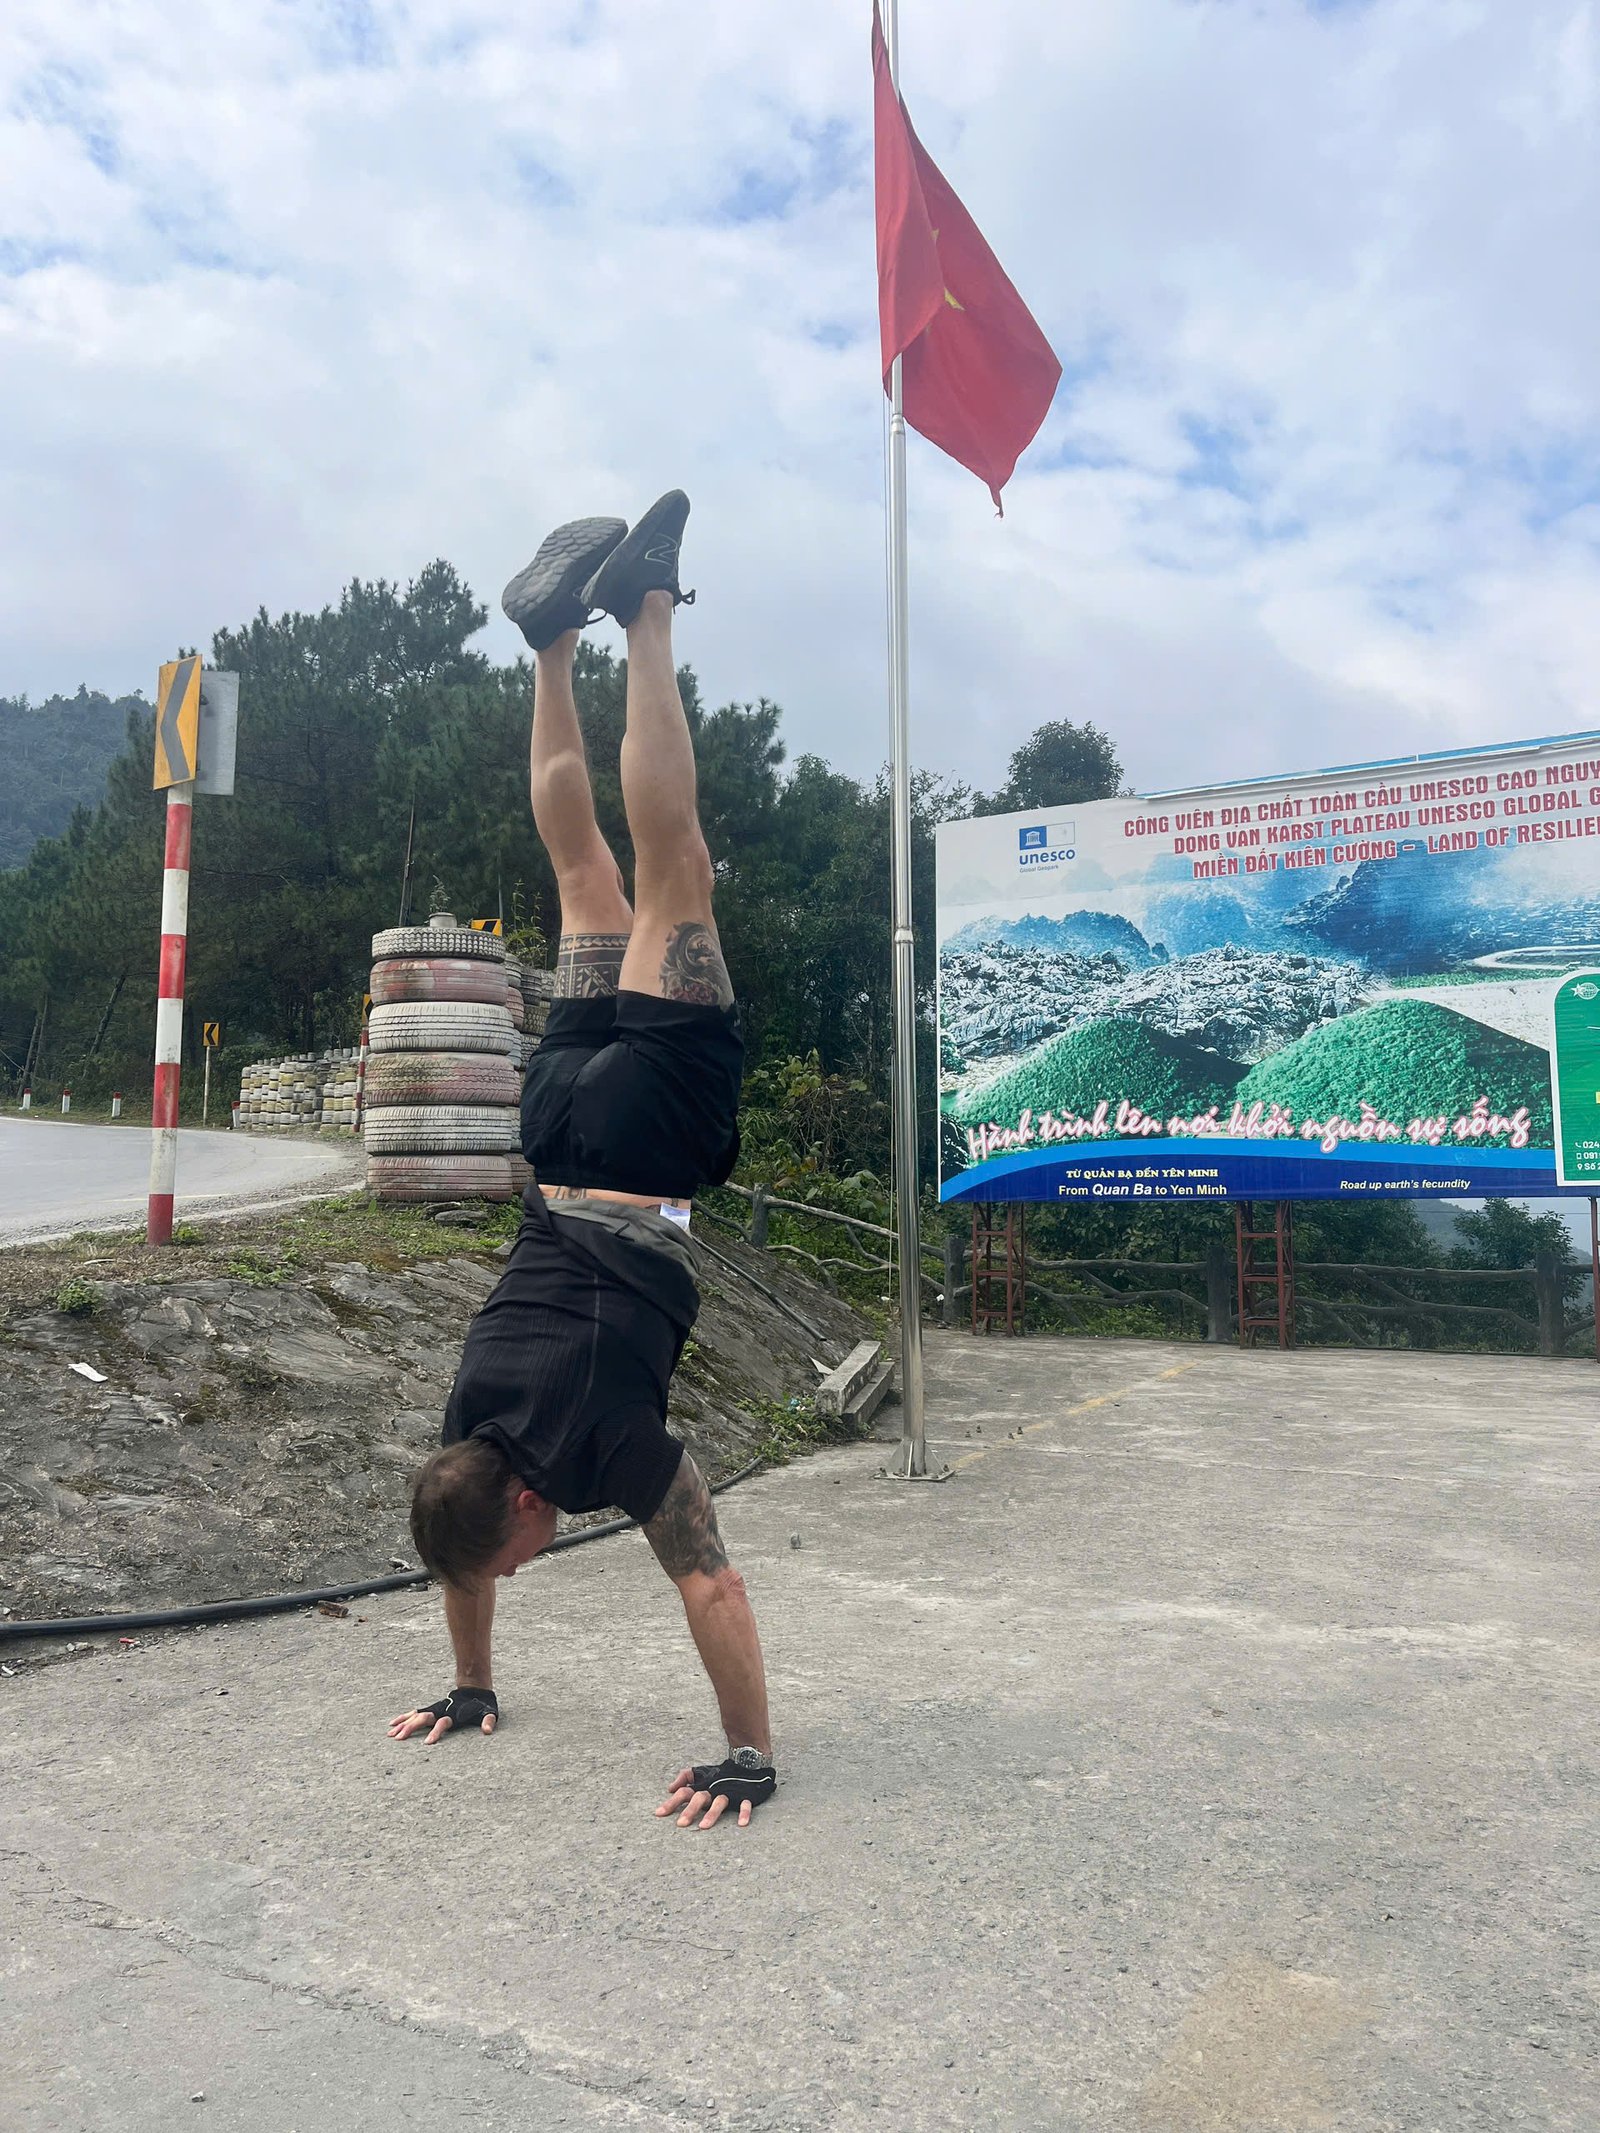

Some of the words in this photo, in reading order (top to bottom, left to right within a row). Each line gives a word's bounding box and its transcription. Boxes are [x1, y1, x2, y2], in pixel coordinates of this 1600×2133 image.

[1124, 815, 1169, 837] CÔNG
[1175, 808, 1214, 831] VIÊN
[1221, 806, 1251, 827] ĐỊA
[1257, 794, 1303, 821] CHẤT
[1309, 791, 1357, 815] TOÀN
[1364, 782, 1401, 807] CẦU
[1409, 775, 1489, 802] UNESCO
[1496, 769, 1537, 791] CAO
[1174, 833, 1220, 854] DONG
[1226, 828, 1260, 848] VAN
[1267, 820, 1324, 844] KARST
[1331, 811, 1410, 837] PLATEAU
[1417, 800, 1496, 826] UNESCO
[1503, 789, 1582, 816] GLOBAL
[1193, 852, 1238, 878] MIỀN
[1245, 848, 1278, 873] ĐẤT
[1284, 845, 1326, 868] KIÊN
[1333, 840, 1397, 863] CƯỜNG
[1428, 830, 1478, 854] LAND
[1485, 827, 1510, 846] OF
[1516, 815, 1600, 843] RESILIE
[1019, 849, 1076, 865] unesco
[967, 1108, 1034, 1161] Hành
[1038, 1100, 1110, 1140] trình
[1114, 1100, 1162, 1135] lên
[1168, 1106, 1220, 1135] nơi
[1227, 1100, 1294, 1137] khởi
[1300, 1101, 1400, 1152] nguồn
[1405, 1116, 1447, 1146] sự
[1453, 1095, 1530, 1147] sống
[1583, 1152, 1600, 1160] 091
[1066, 1169, 1082, 1178] TỪ
[1084, 1167, 1115, 1179] QUẢN
[1118, 1169, 1133, 1179] BẠ
[1136, 1167, 1159, 1178] ĐẾN
[1161, 1168, 1186, 1177] YÊN
[1188, 1169, 1219, 1177] MINH
[1059, 1185, 1089, 1195] From
[1092, 1183, 1130, 1196] Quan
[1133, 1183, 1152, 1195] Ba
[1155, 1186, 1168, 1195] to
[1170, 1185, 1194, 1195] Yen
[1196, 1184, 1227, 1195] Minh
[1340, 1180, 1366, 1189] Road
[1368, 1182, 1382, 1191] up
[1422, 1179, 1471, 1191] fecundity
